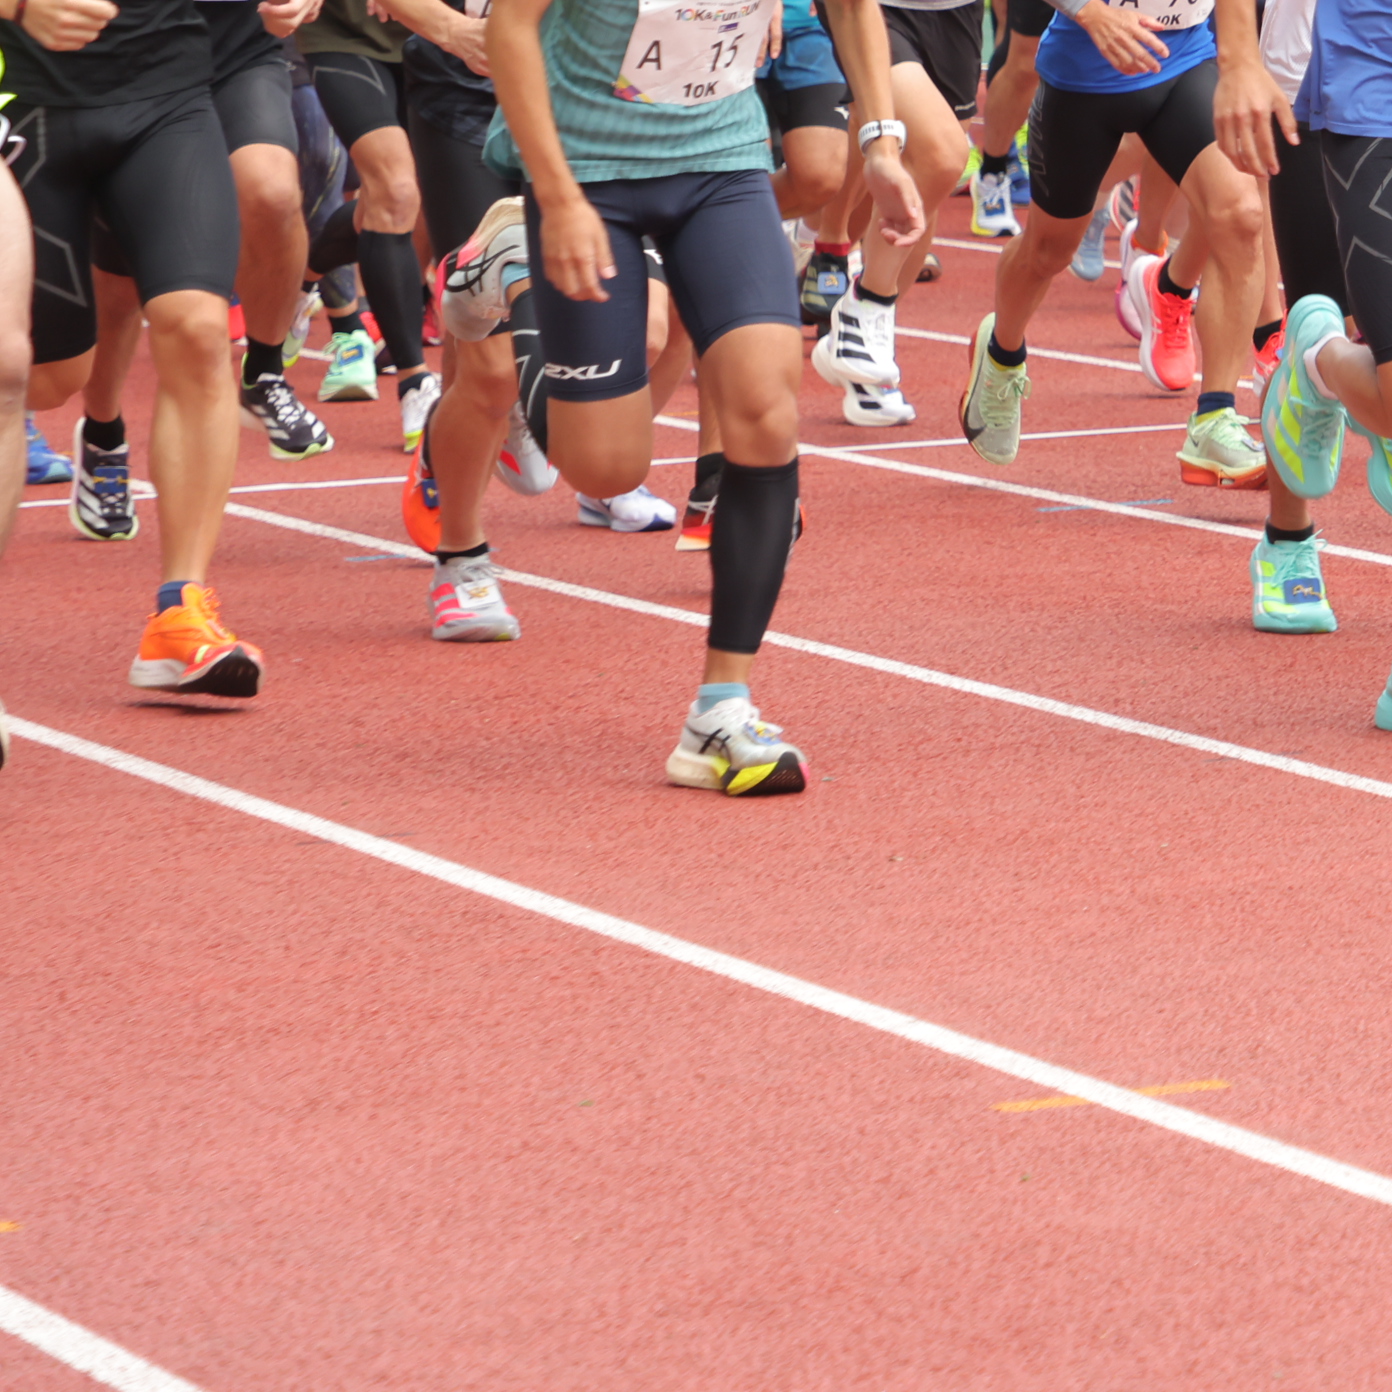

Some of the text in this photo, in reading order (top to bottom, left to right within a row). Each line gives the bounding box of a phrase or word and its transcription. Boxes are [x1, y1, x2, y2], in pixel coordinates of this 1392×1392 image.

[636, 33, 745, 72] A 15
[683, 80, 719, 99] 10K
